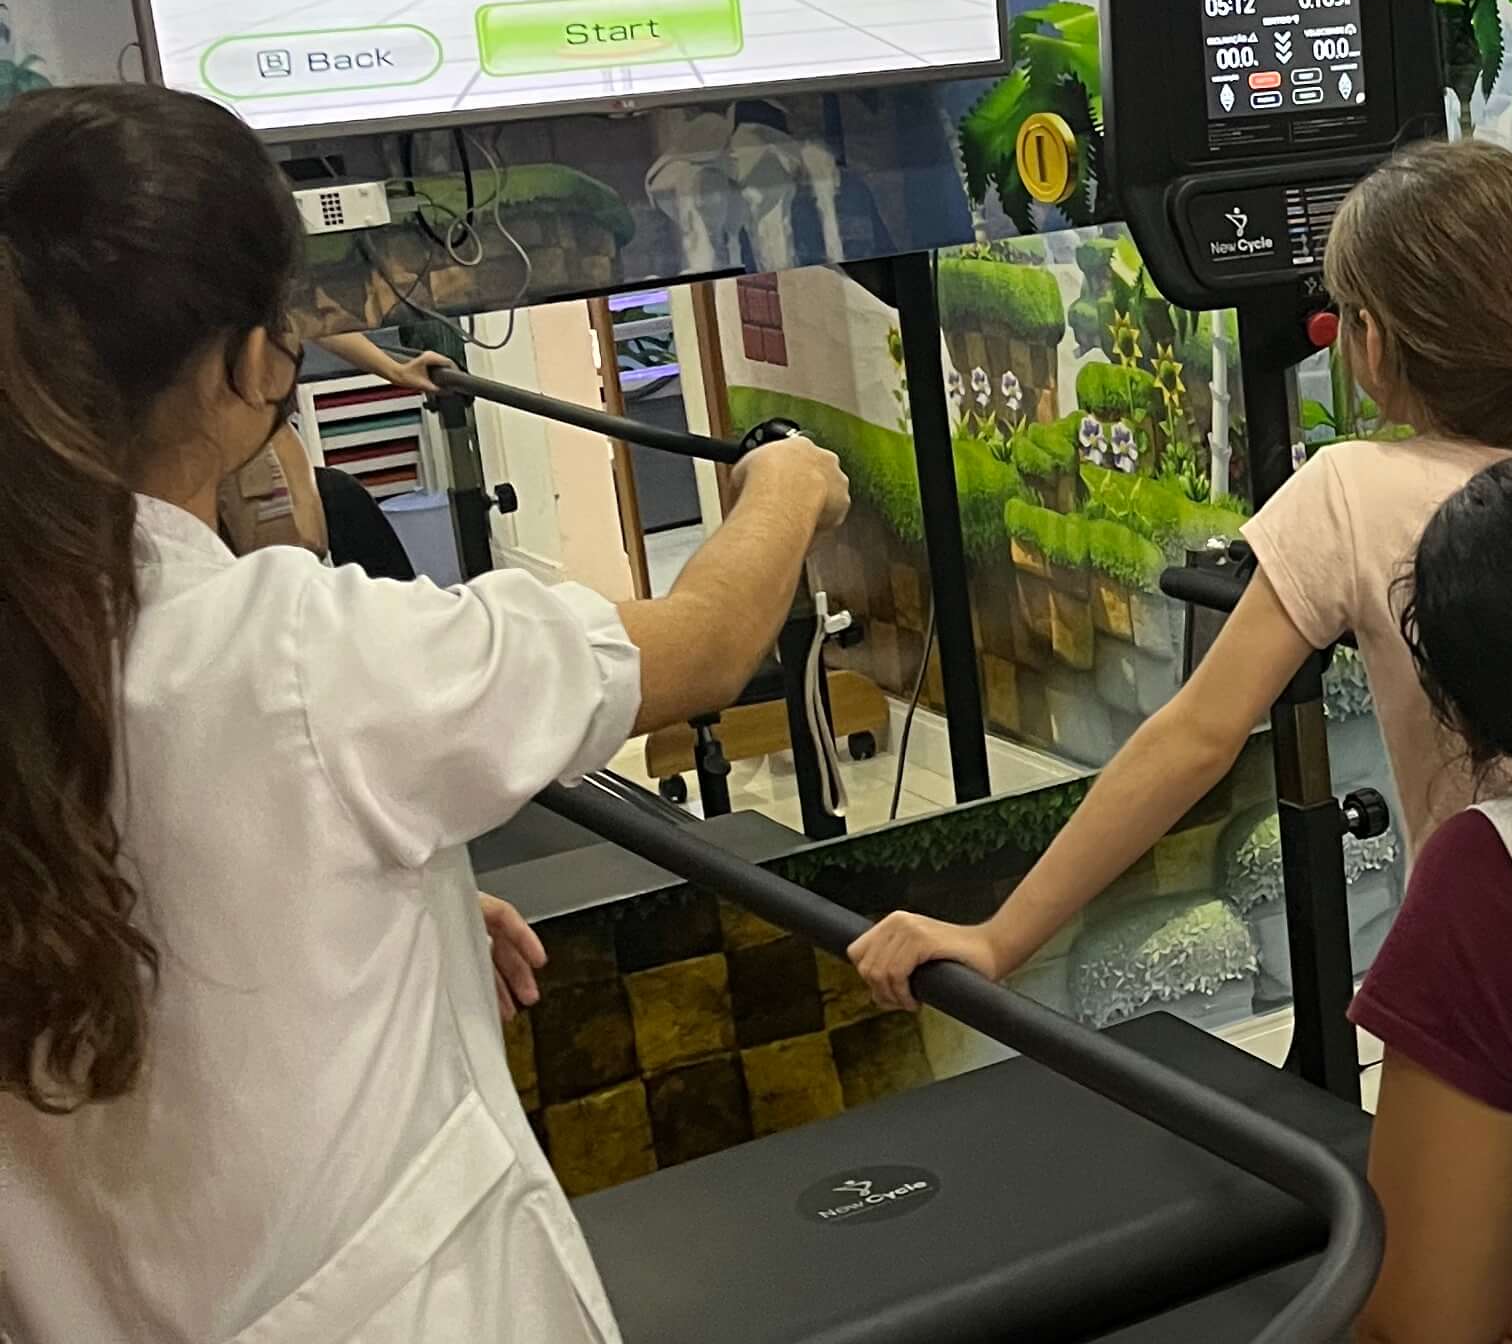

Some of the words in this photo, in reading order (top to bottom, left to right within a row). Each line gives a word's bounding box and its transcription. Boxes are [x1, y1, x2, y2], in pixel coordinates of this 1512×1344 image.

[566, 19, 660, 45] Start
[307, 48, 394, 72] Back
[1211, 242, 1237, 254] New
[1237, 237, 1274, 253] Cycle
[865, 1181, 928, 1203] Cycle
